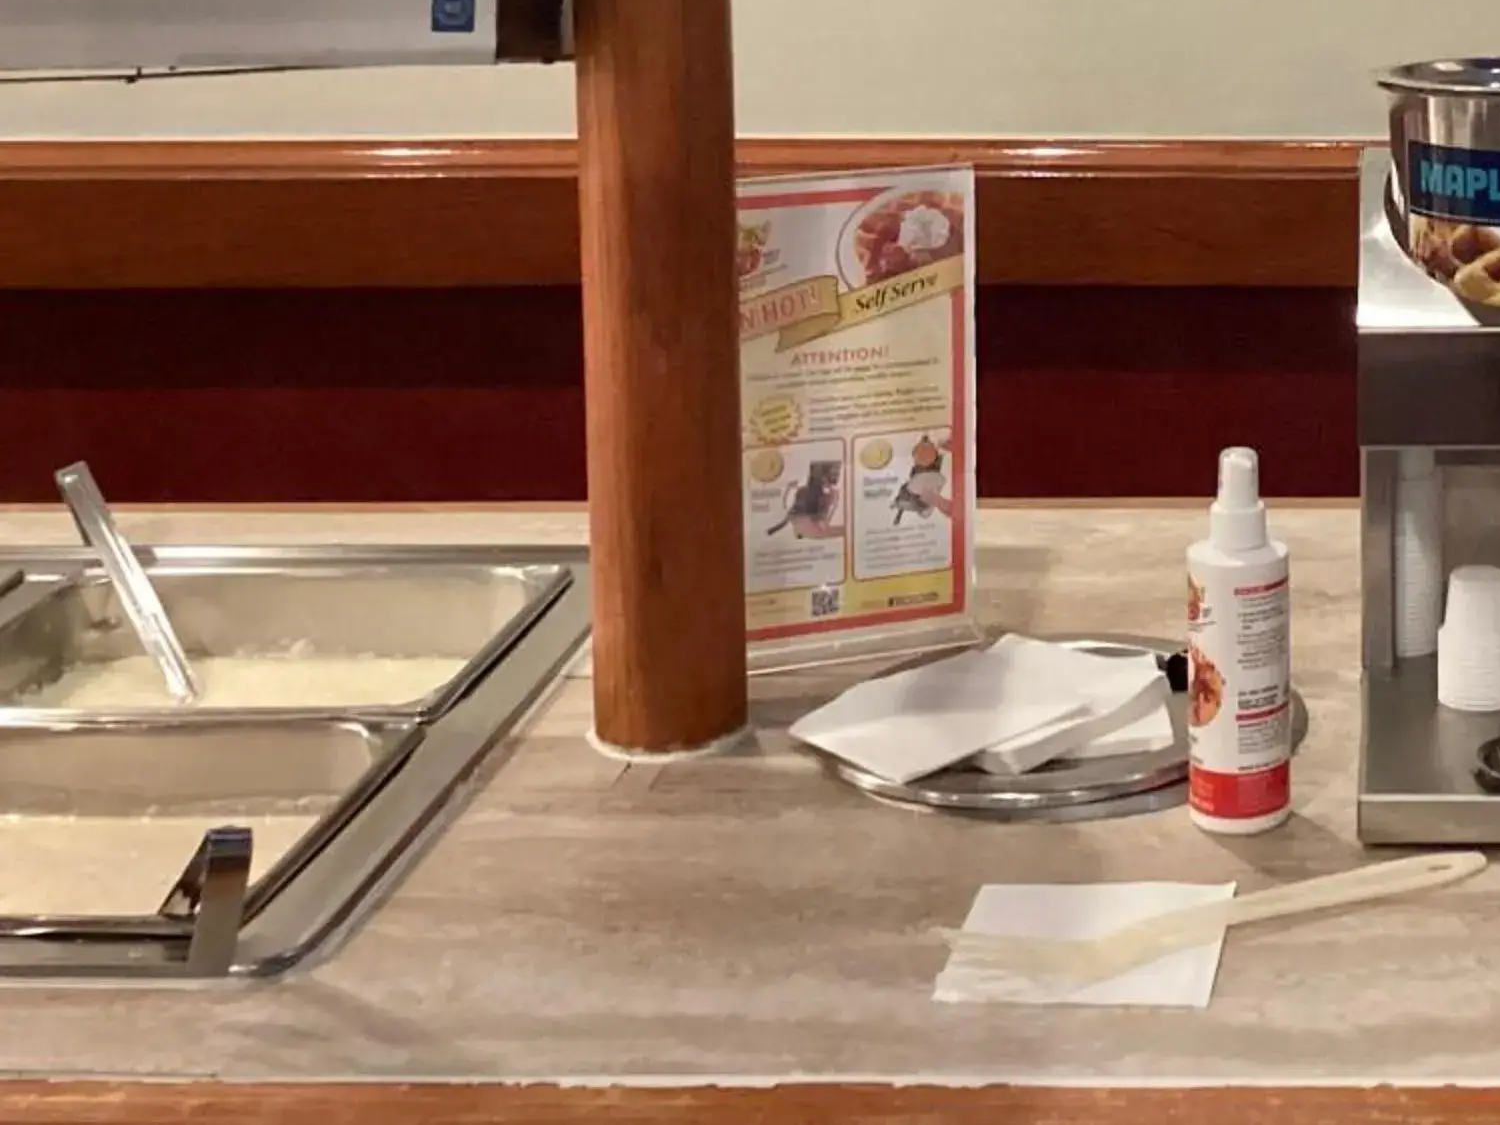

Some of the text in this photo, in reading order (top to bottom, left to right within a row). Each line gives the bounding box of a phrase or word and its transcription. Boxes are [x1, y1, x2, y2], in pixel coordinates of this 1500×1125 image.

[855, 273, 939, 313] Self Serve
[791, 344, 890, 365] ATTENTION!
